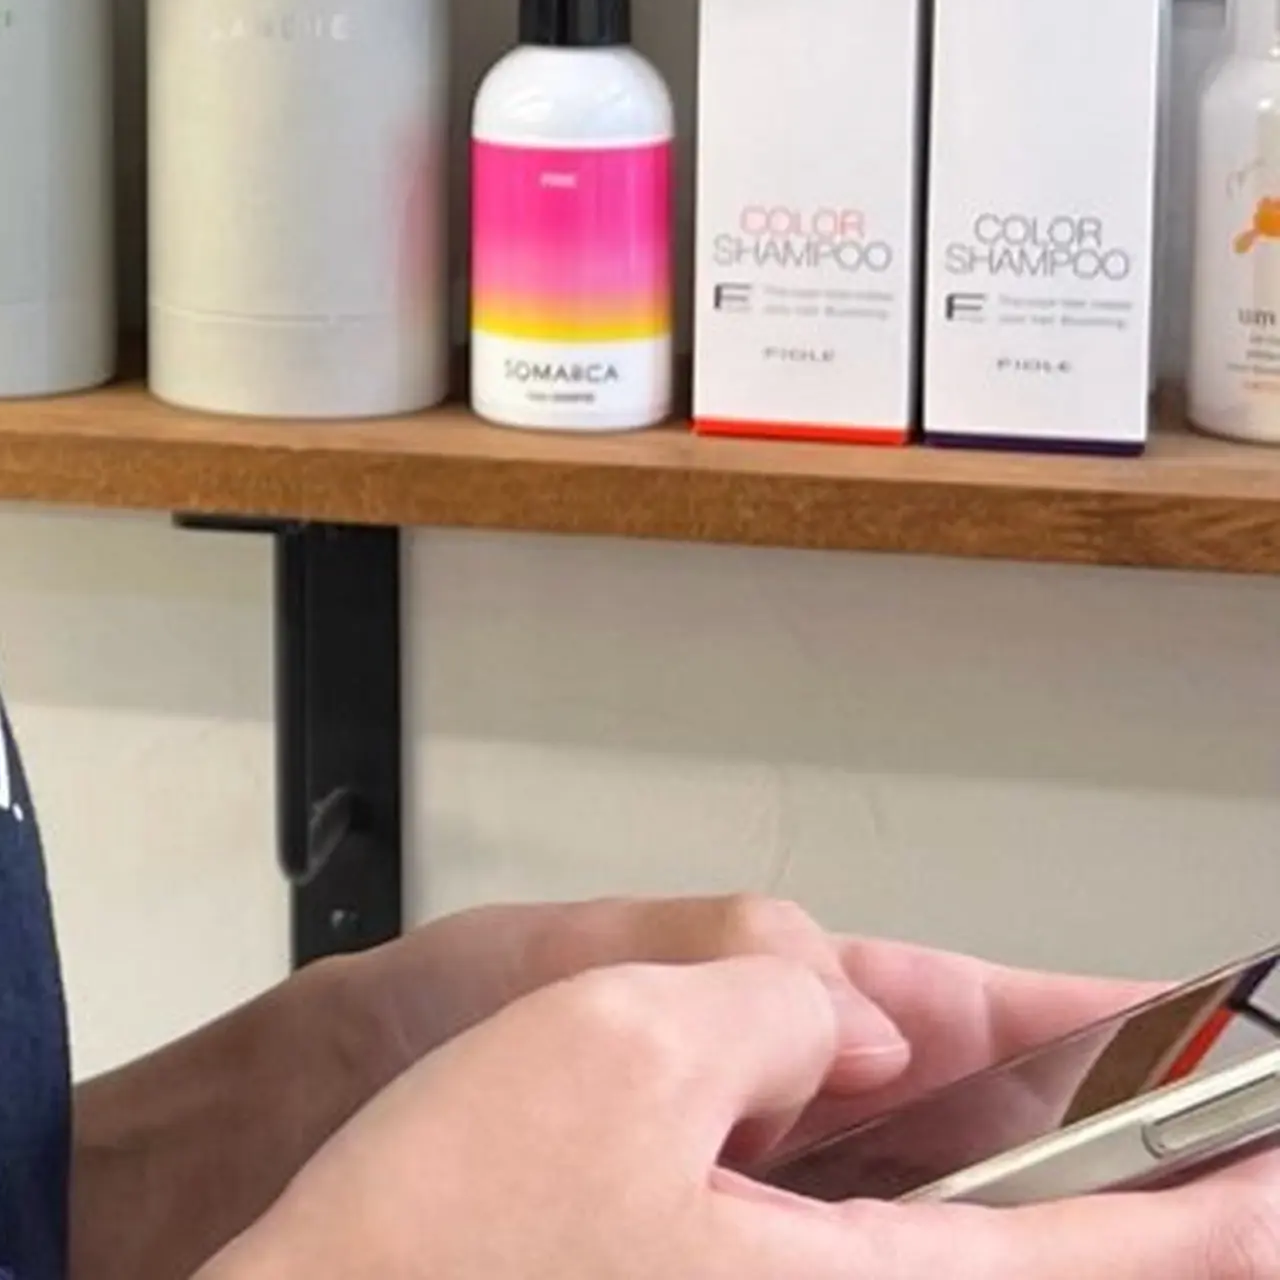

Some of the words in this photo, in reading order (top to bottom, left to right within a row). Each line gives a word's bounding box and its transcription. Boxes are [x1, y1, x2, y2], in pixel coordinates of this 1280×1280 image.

[740, 204, 866, 239] COLOR
[973, 212, 1103, 248] COLOR
[712, 232, 893, 273] SHAMPOO
[943, 242, 1131, 282] SHAMPOO
